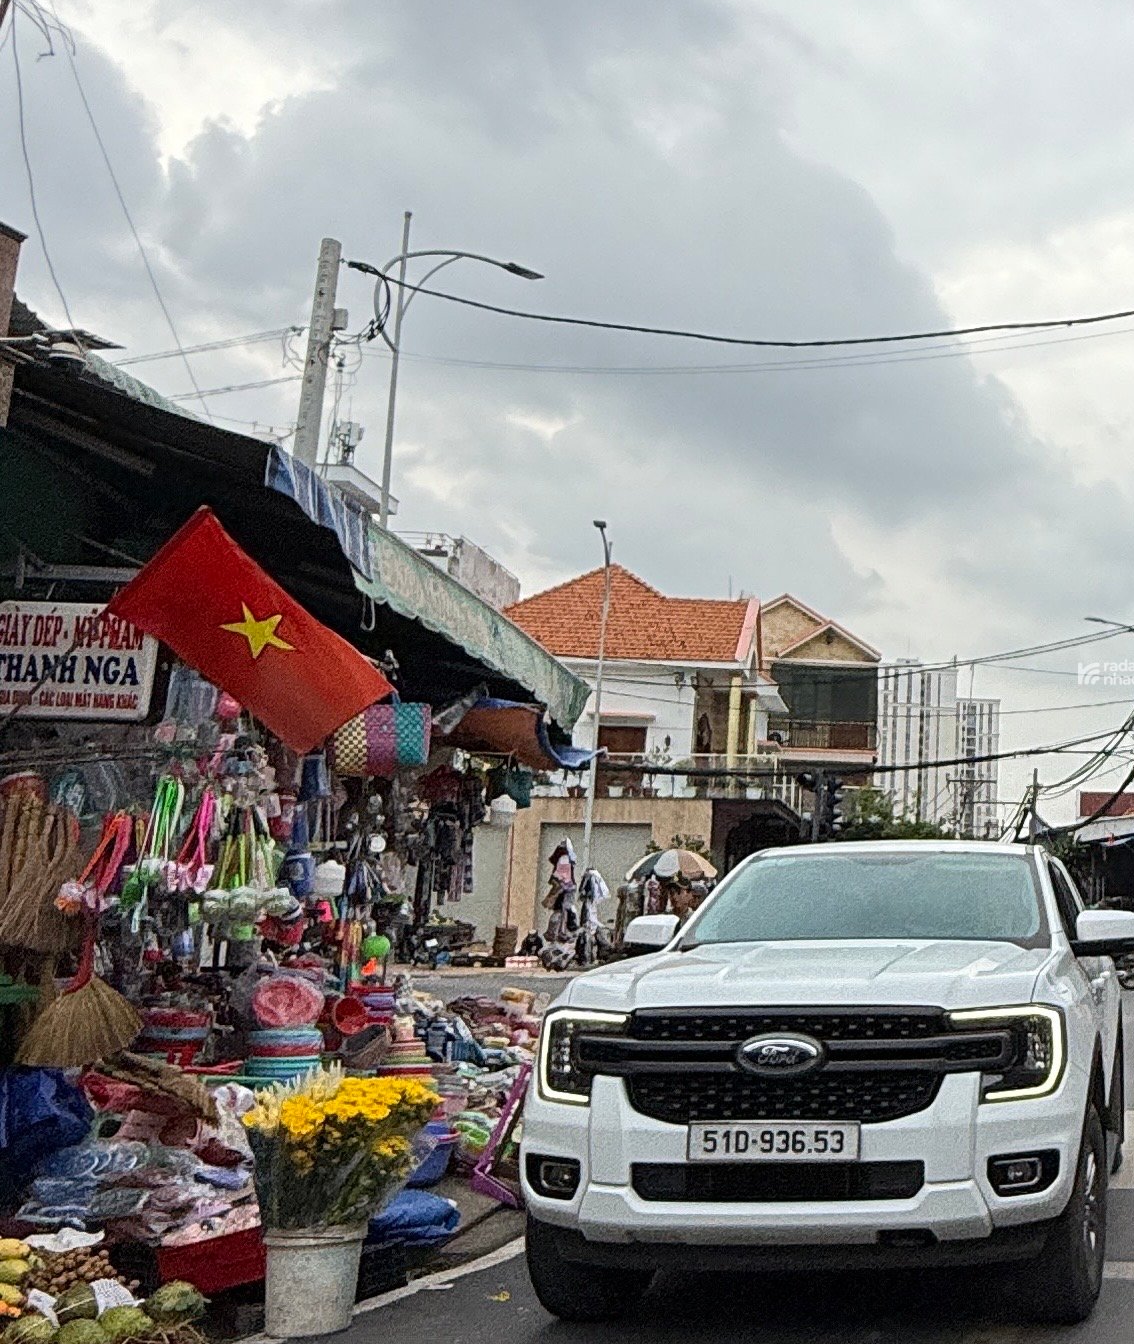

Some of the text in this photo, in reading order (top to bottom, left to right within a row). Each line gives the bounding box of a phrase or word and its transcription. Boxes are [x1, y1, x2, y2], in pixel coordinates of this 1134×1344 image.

[32, 607, 63, 647] DÉP
[83, 655, 139, 686] NGA
[757, 1045, 800, 1066] Ford
[703, 1130, 845, 1155] 51D-936.53
